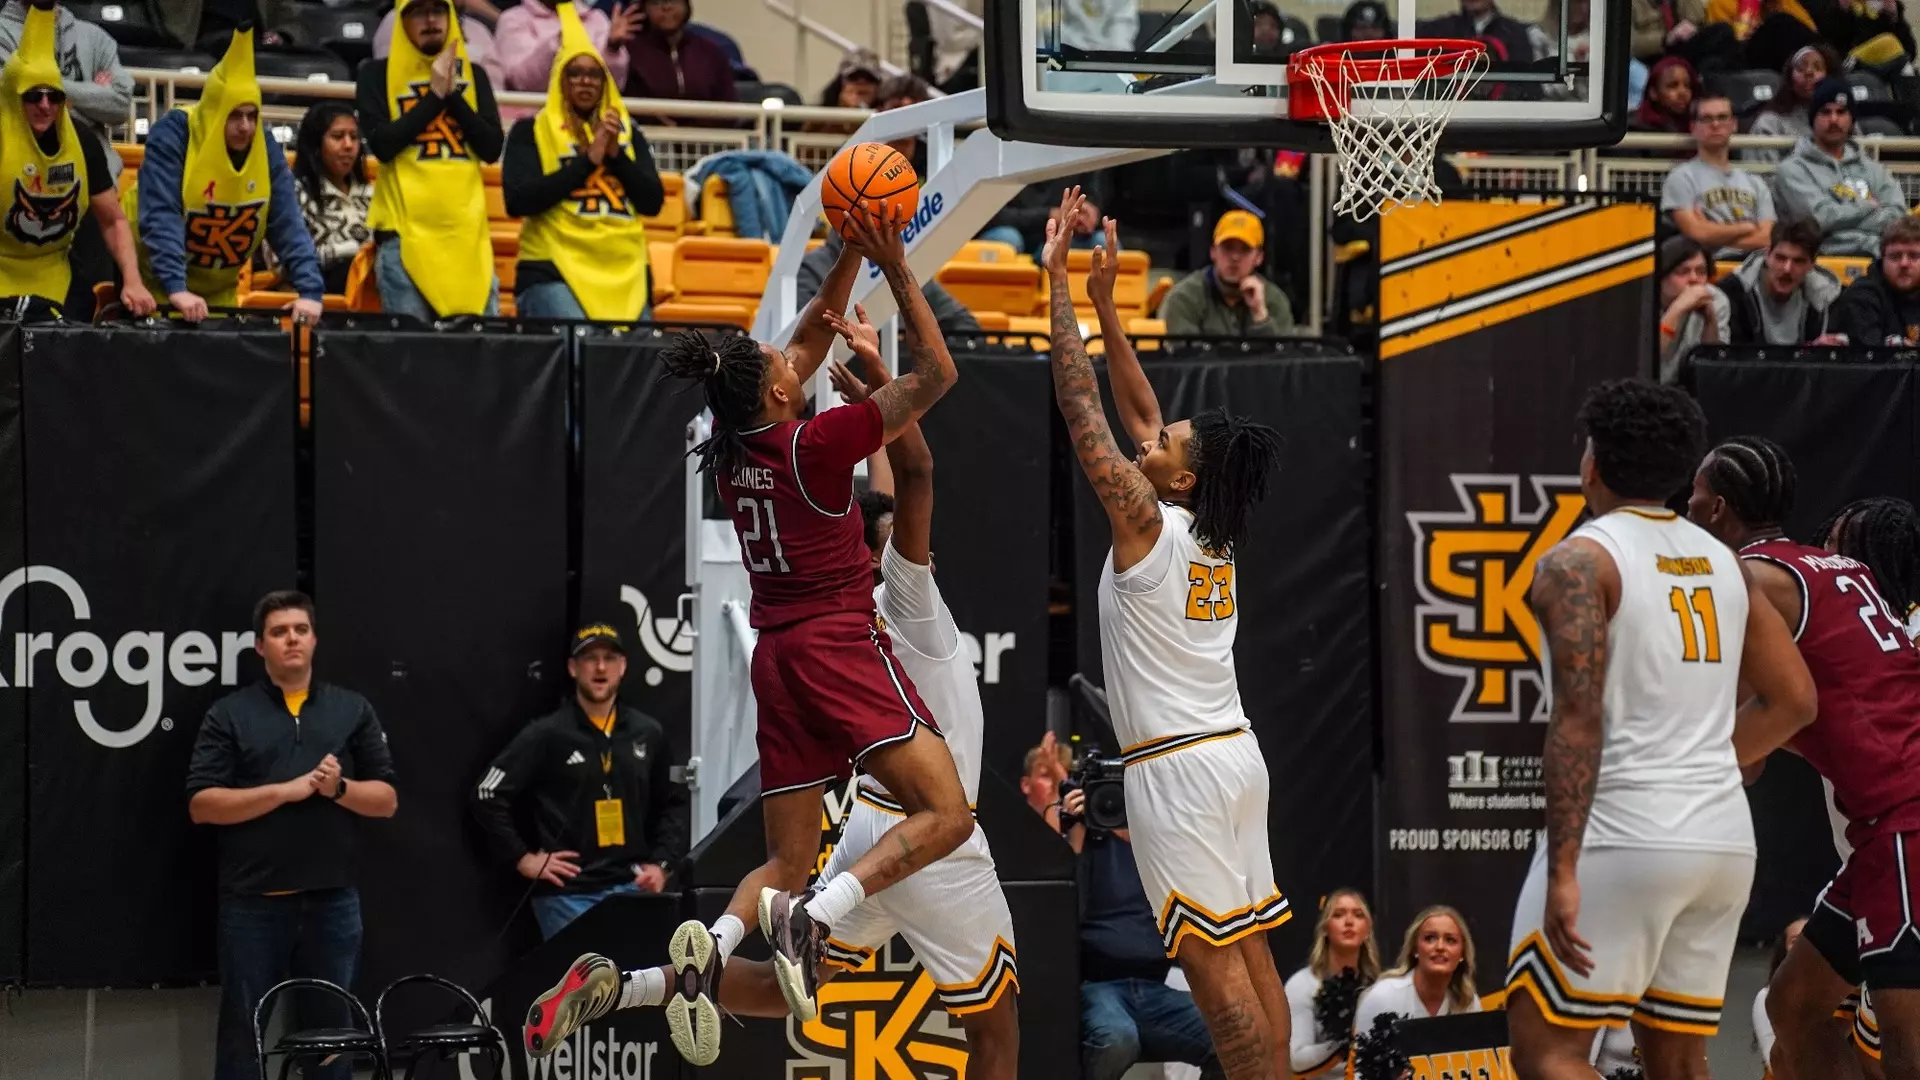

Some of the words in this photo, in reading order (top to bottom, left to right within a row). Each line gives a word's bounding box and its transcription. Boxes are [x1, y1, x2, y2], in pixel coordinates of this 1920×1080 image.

[868, 192, 944, 279] Selde
[736, 497, 791, 573] 21
[1185, 561, 1236, 621] 23
[1669, 586, 1722, 663] 11
[0, 565, 256, 748] roger
[1448, 792, 1486, 809] Where
[1487, 792, 1530, 809] students
[1389, 829, 1439, 850] PROUD
[1442, 829, 1510, 850] SPONSOR
[1513, 829, 1532, 850] OF
